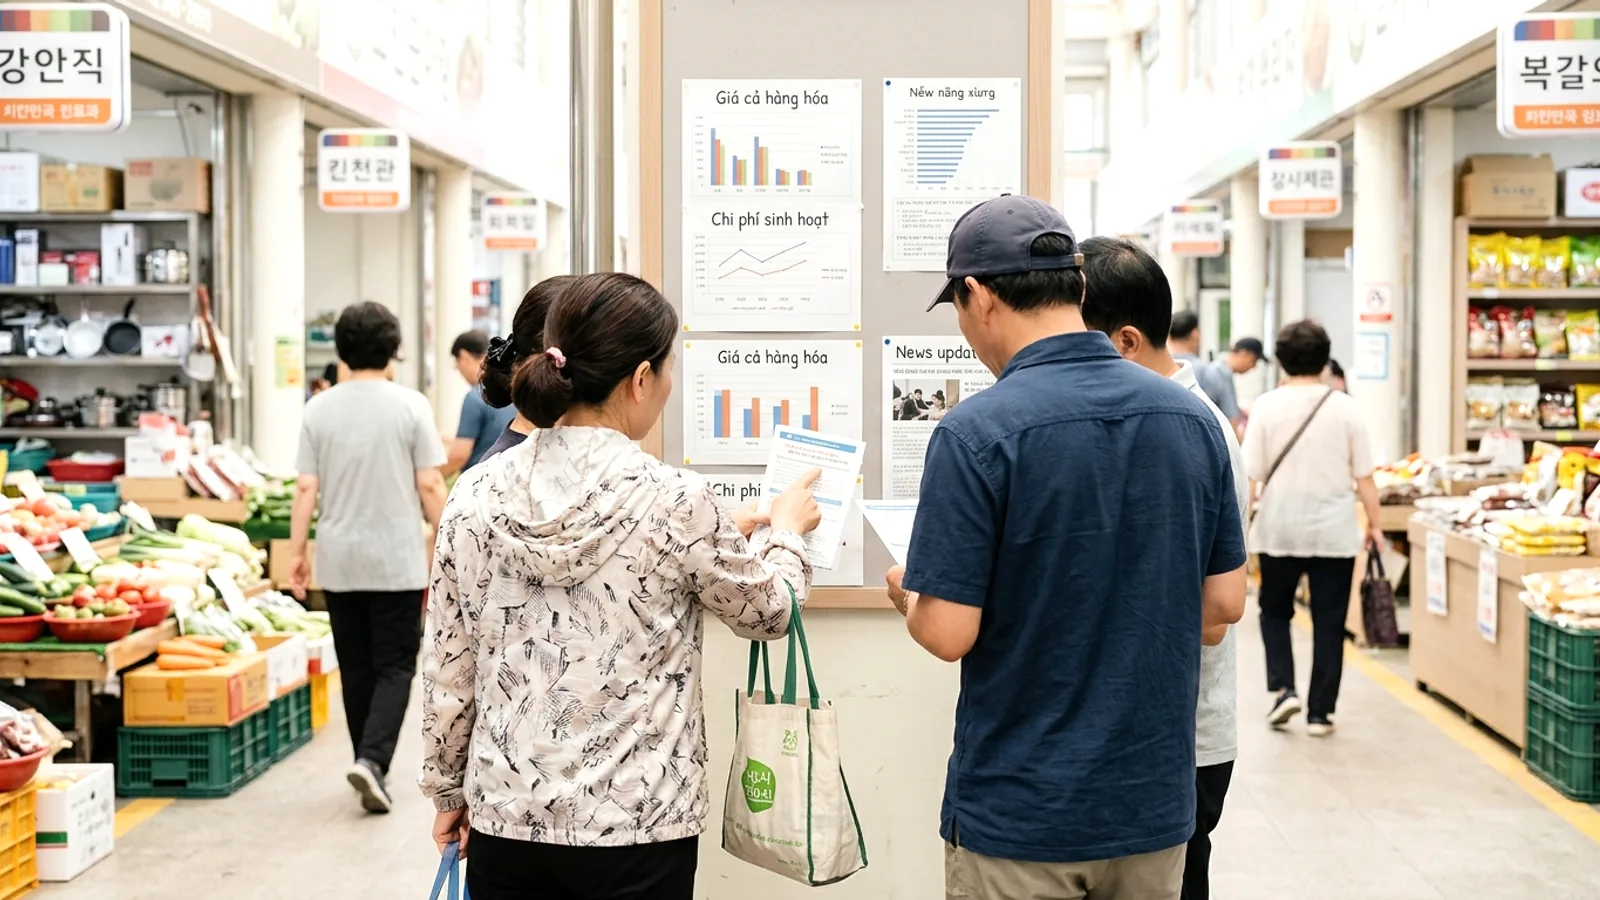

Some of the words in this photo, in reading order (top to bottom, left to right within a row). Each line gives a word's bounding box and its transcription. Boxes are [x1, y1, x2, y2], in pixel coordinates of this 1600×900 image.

[0, 48, 103, 84] 강안직
[716, 90, 740, 105] Giá
[744, 90, 761, 105] cả
[765, 90, 799, 110] hàng
[803, 90, 829, 105] hóa
[711, 212, 734, 227] Chi
[738, 211, 760, 232] phí
[764, 212, 793, 227] sinh
[797, 211, 830, 229] hoạt
[717, 349, 740, 365] Giá
[744, 349, 761, 365] cả
[765, 349, 799, 370] hàng
[803, 349, 828, 365] hóa
[896, 345, 933, 359] News
[937, 344, 977, 363] updat
[712, 483, 735, 497] Chi
